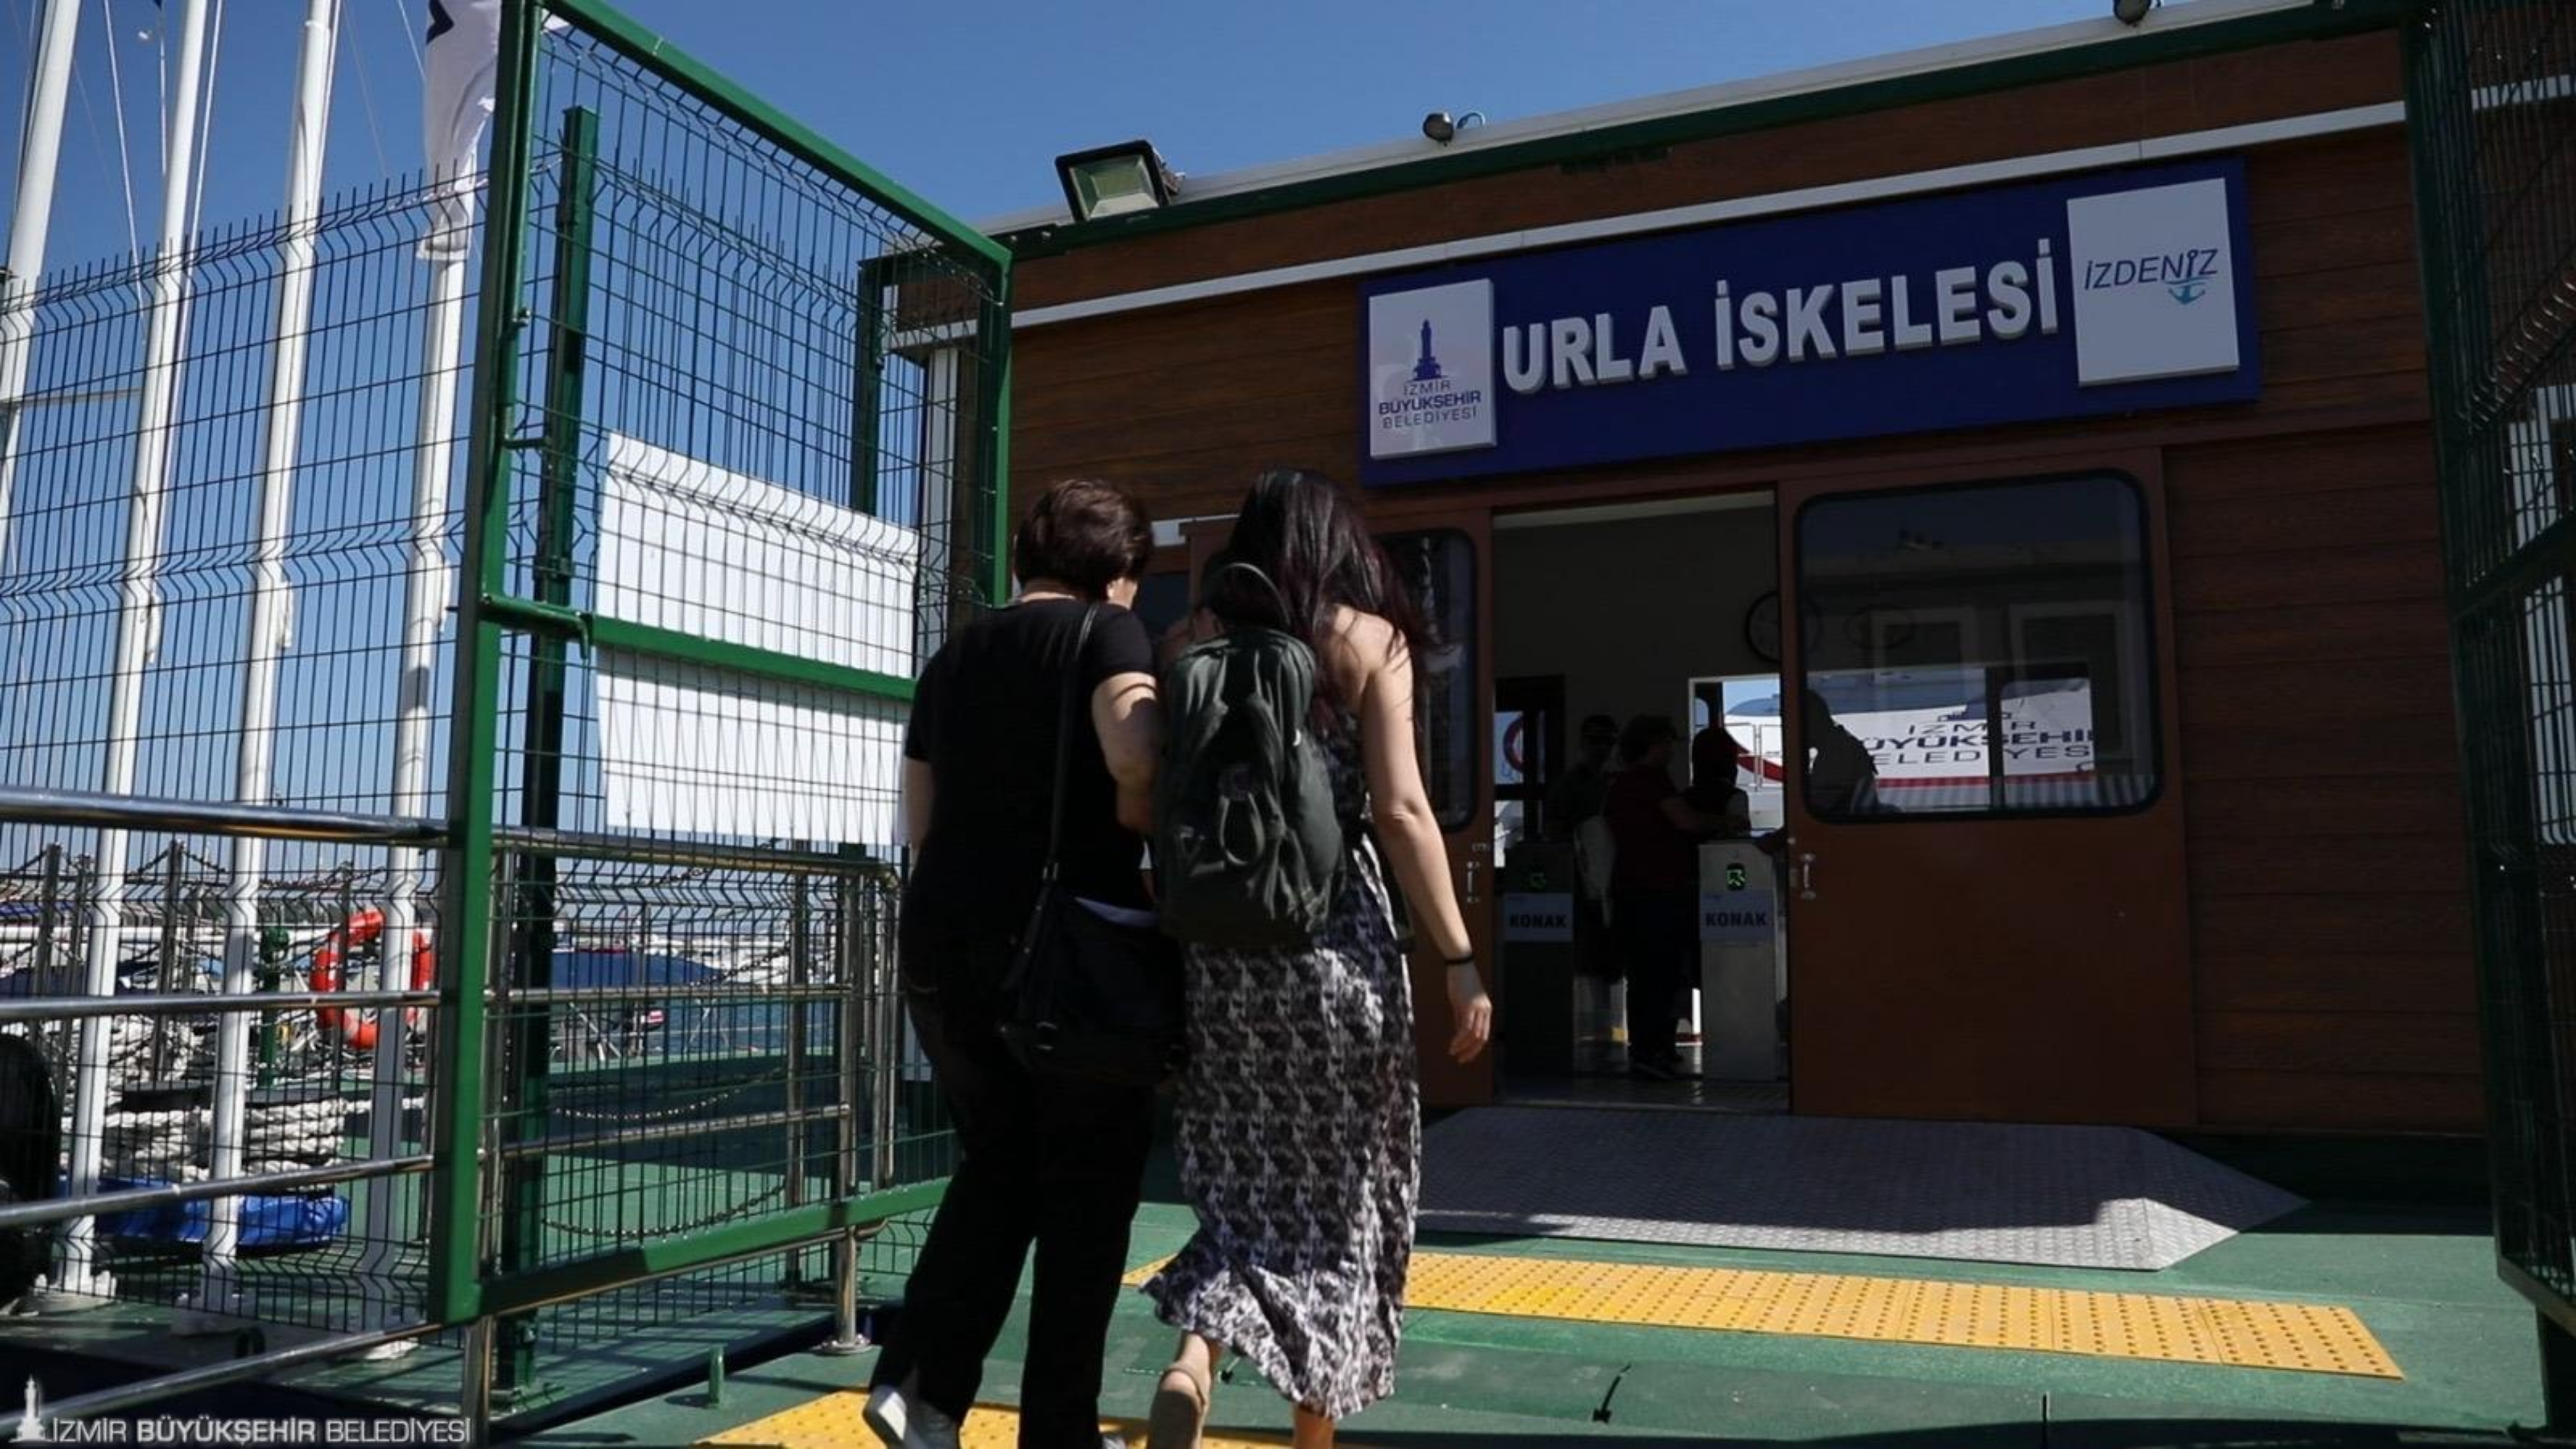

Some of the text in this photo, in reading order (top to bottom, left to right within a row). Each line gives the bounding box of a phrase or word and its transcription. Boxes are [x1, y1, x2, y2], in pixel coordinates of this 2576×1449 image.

[2085, 248, 2219, 290] İZDENİZ
[1503, 237, 2058, 395] URLA İSKELESİ
[1510, 914, 1567, 927] KONAK
[1706, 913, 1766, 926] KONAK
